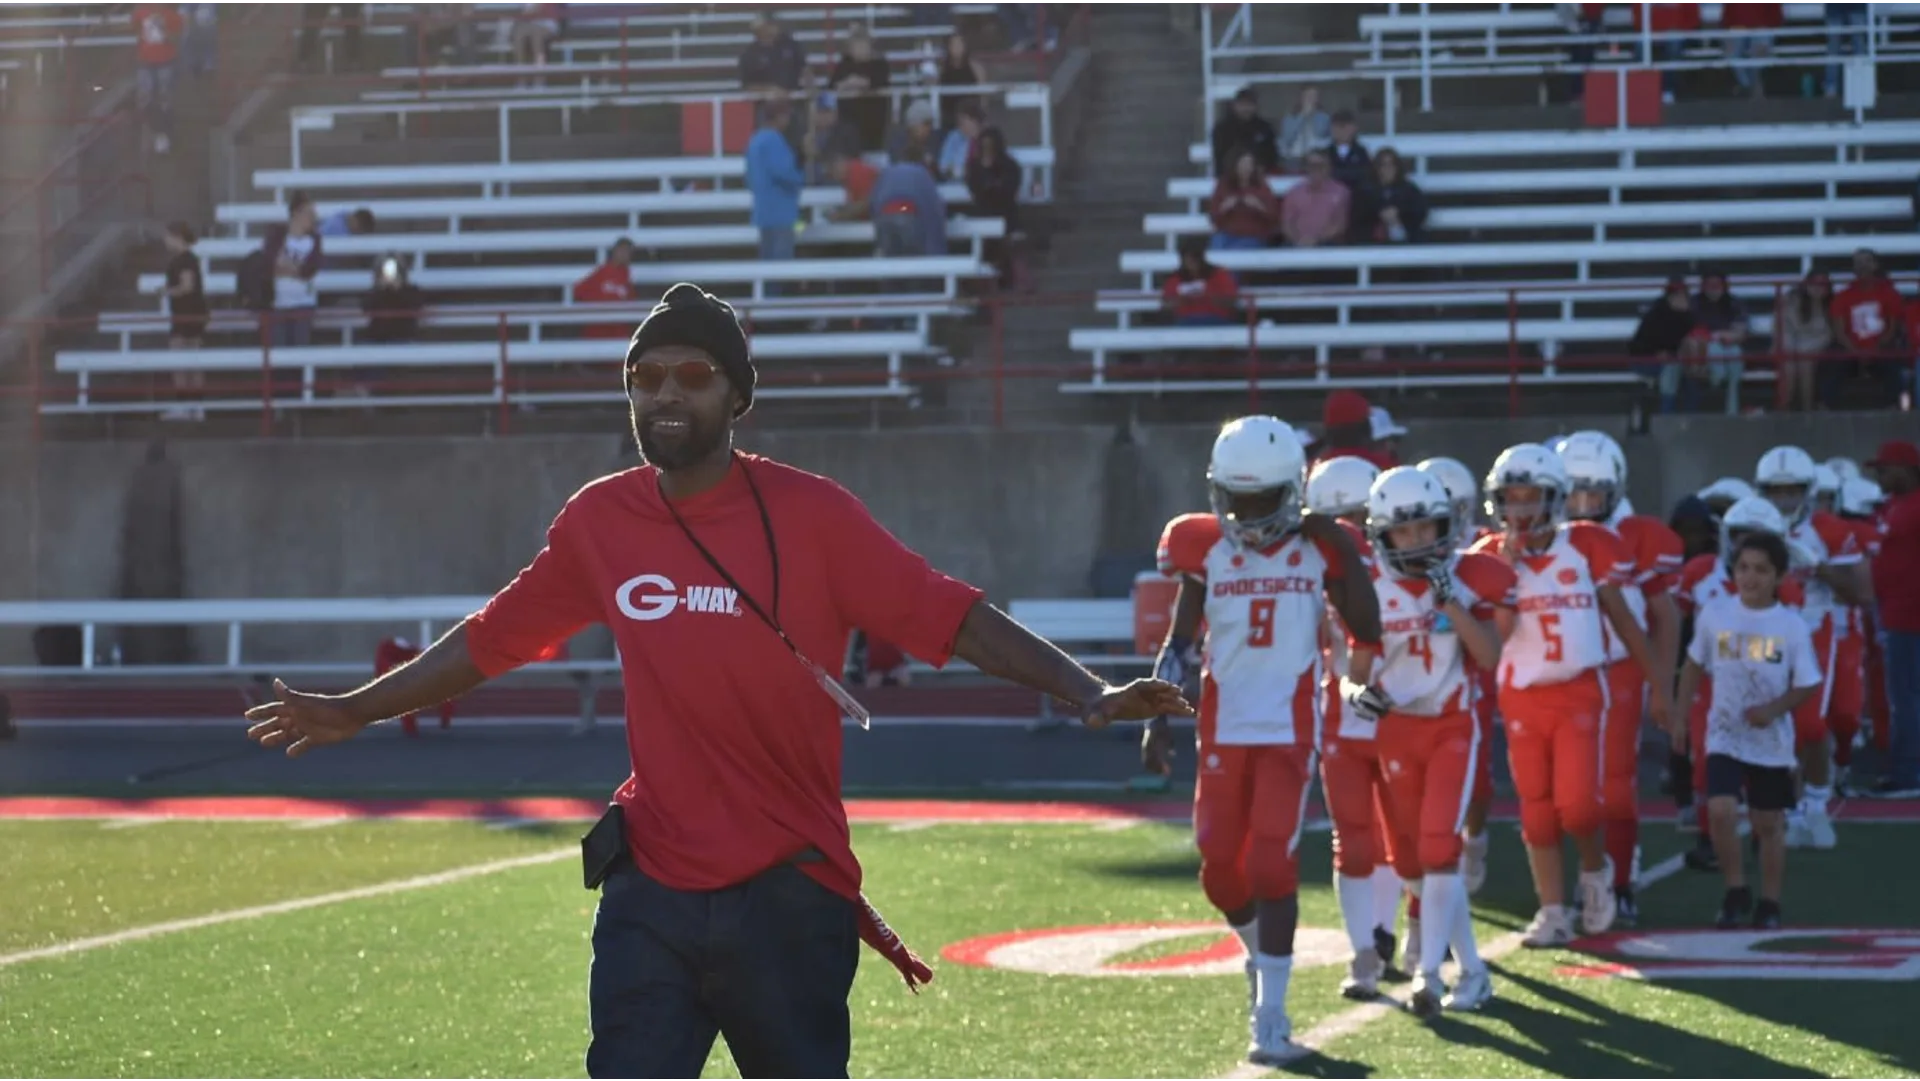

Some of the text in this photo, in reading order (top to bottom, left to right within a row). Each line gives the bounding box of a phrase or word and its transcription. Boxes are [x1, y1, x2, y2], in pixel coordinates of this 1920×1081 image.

[615, 573, 738, 621] G-WAY
[1247, 598, 1276, 649] 9
[1539, 613, 1564, 662] 5
[1409, 633, 1432, 676] 4
